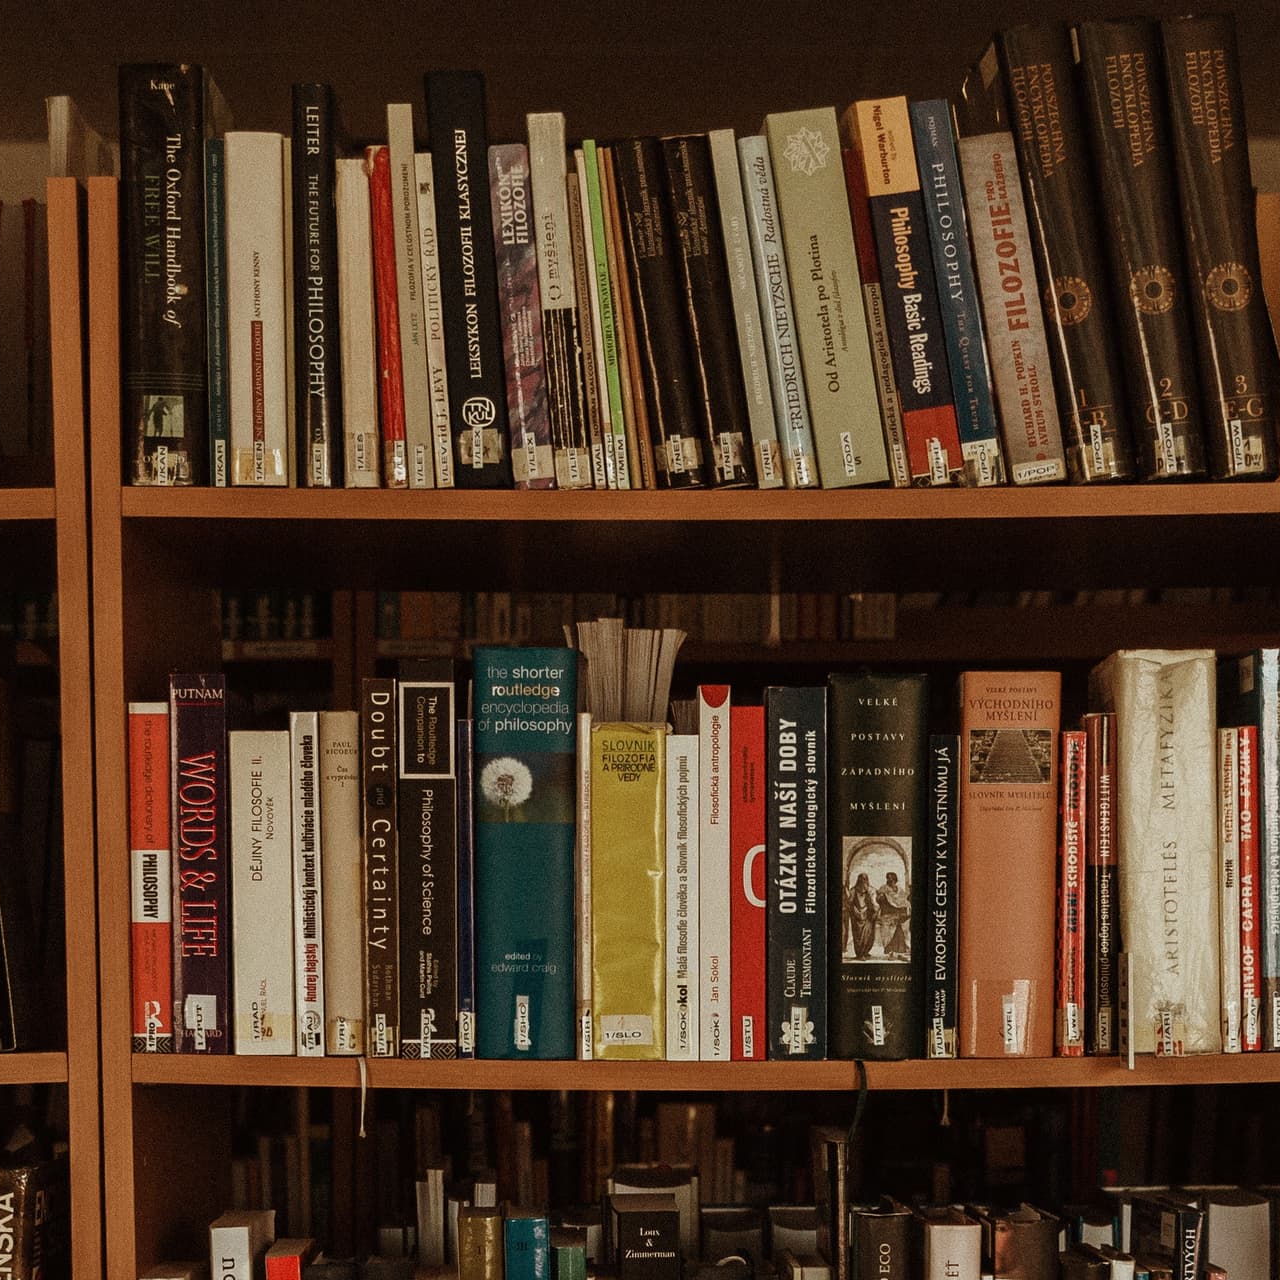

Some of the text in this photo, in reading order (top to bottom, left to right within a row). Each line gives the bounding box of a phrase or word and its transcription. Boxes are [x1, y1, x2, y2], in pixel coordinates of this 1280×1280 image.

[163, 133, 183, 328] The Oxford Handbook of
[455, 129, 482, 379] LEKSYKON FILOZOFII KLASYCZNEJ
[890, 207, 932, 395] Philosophy Basic Readings
[487, 666, 564, 679] the shorter
[492, 683, 560, 697] routledge
[481, 701, 569, 716] encyclopedia
[478, 718, 572, 734] of philosophy
[851, 733, 906, 742] POSTAVY
[850, 801, 906, 812] MYŠLENÍ
[774, 717, 797, 914] OTÁZKY NAŠÍ DOBY
[180, 752, 217, 958] WORDS & LIFE
[606, 1030, 641, 1039] 1/SLO
[626, 1250, 675, 1261] Zimmerman
